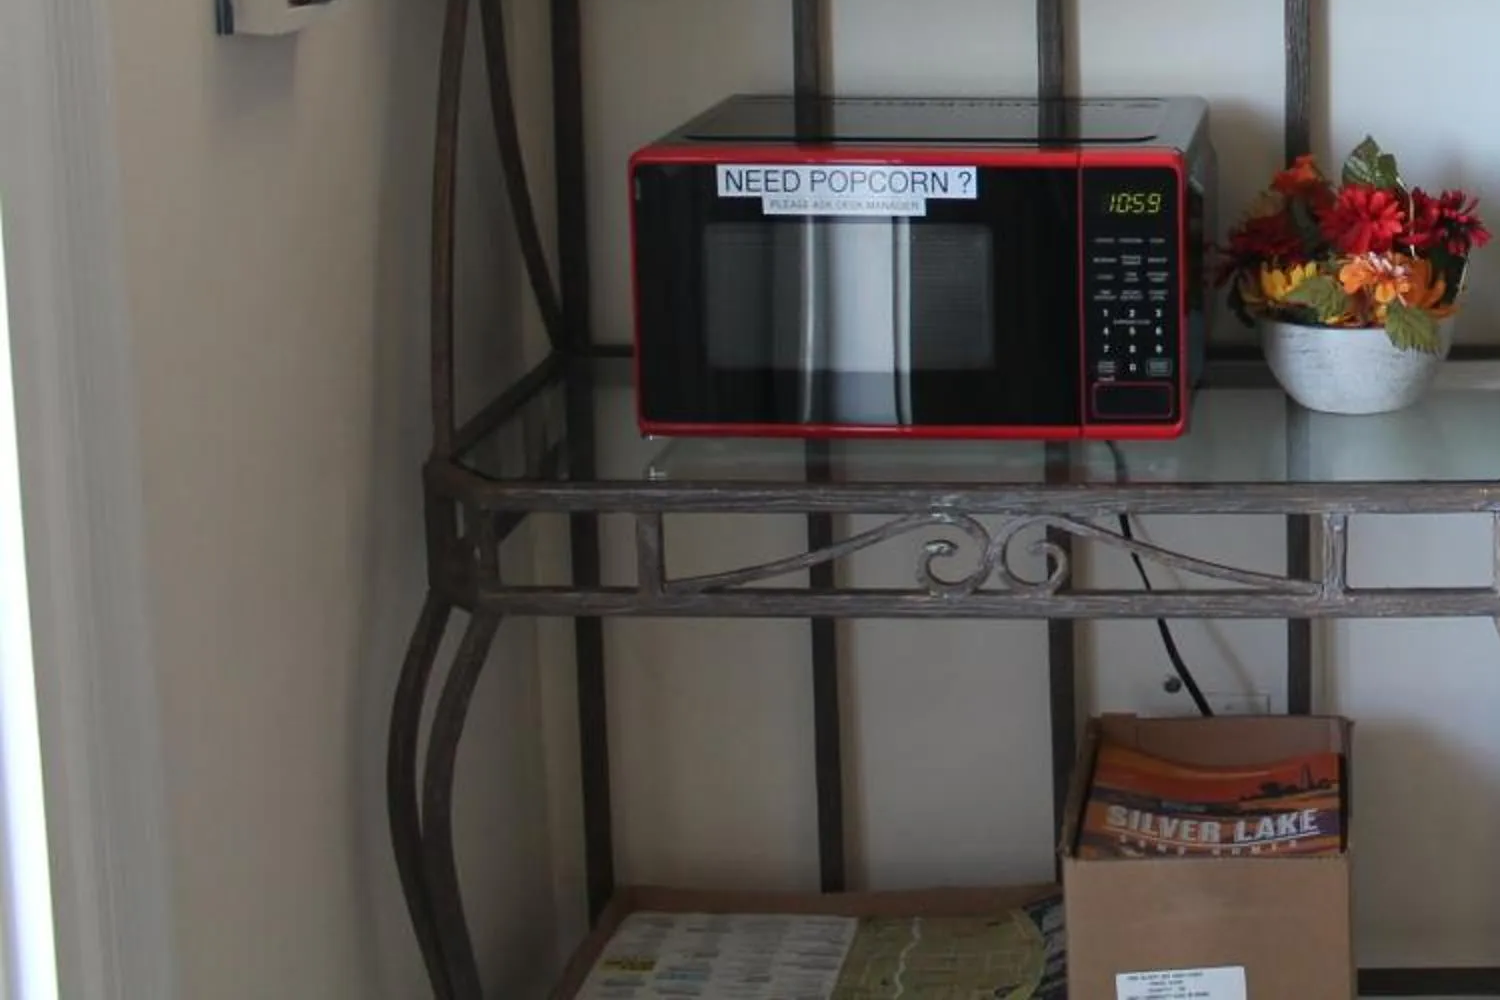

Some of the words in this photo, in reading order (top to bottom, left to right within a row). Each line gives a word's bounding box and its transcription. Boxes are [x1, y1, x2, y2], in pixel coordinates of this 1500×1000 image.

[724, 169, 802, 194] NEED
[809, 170, 950, 195] POPCORN
[956, 171, 973, 195] ?
[769, 199, 808, 209] PLEASE
[864, 201, 920, 211] MANAGER
[1106, 803, 1222, 845] SILVER
[1233, 807, 1321, 844] LAKE
